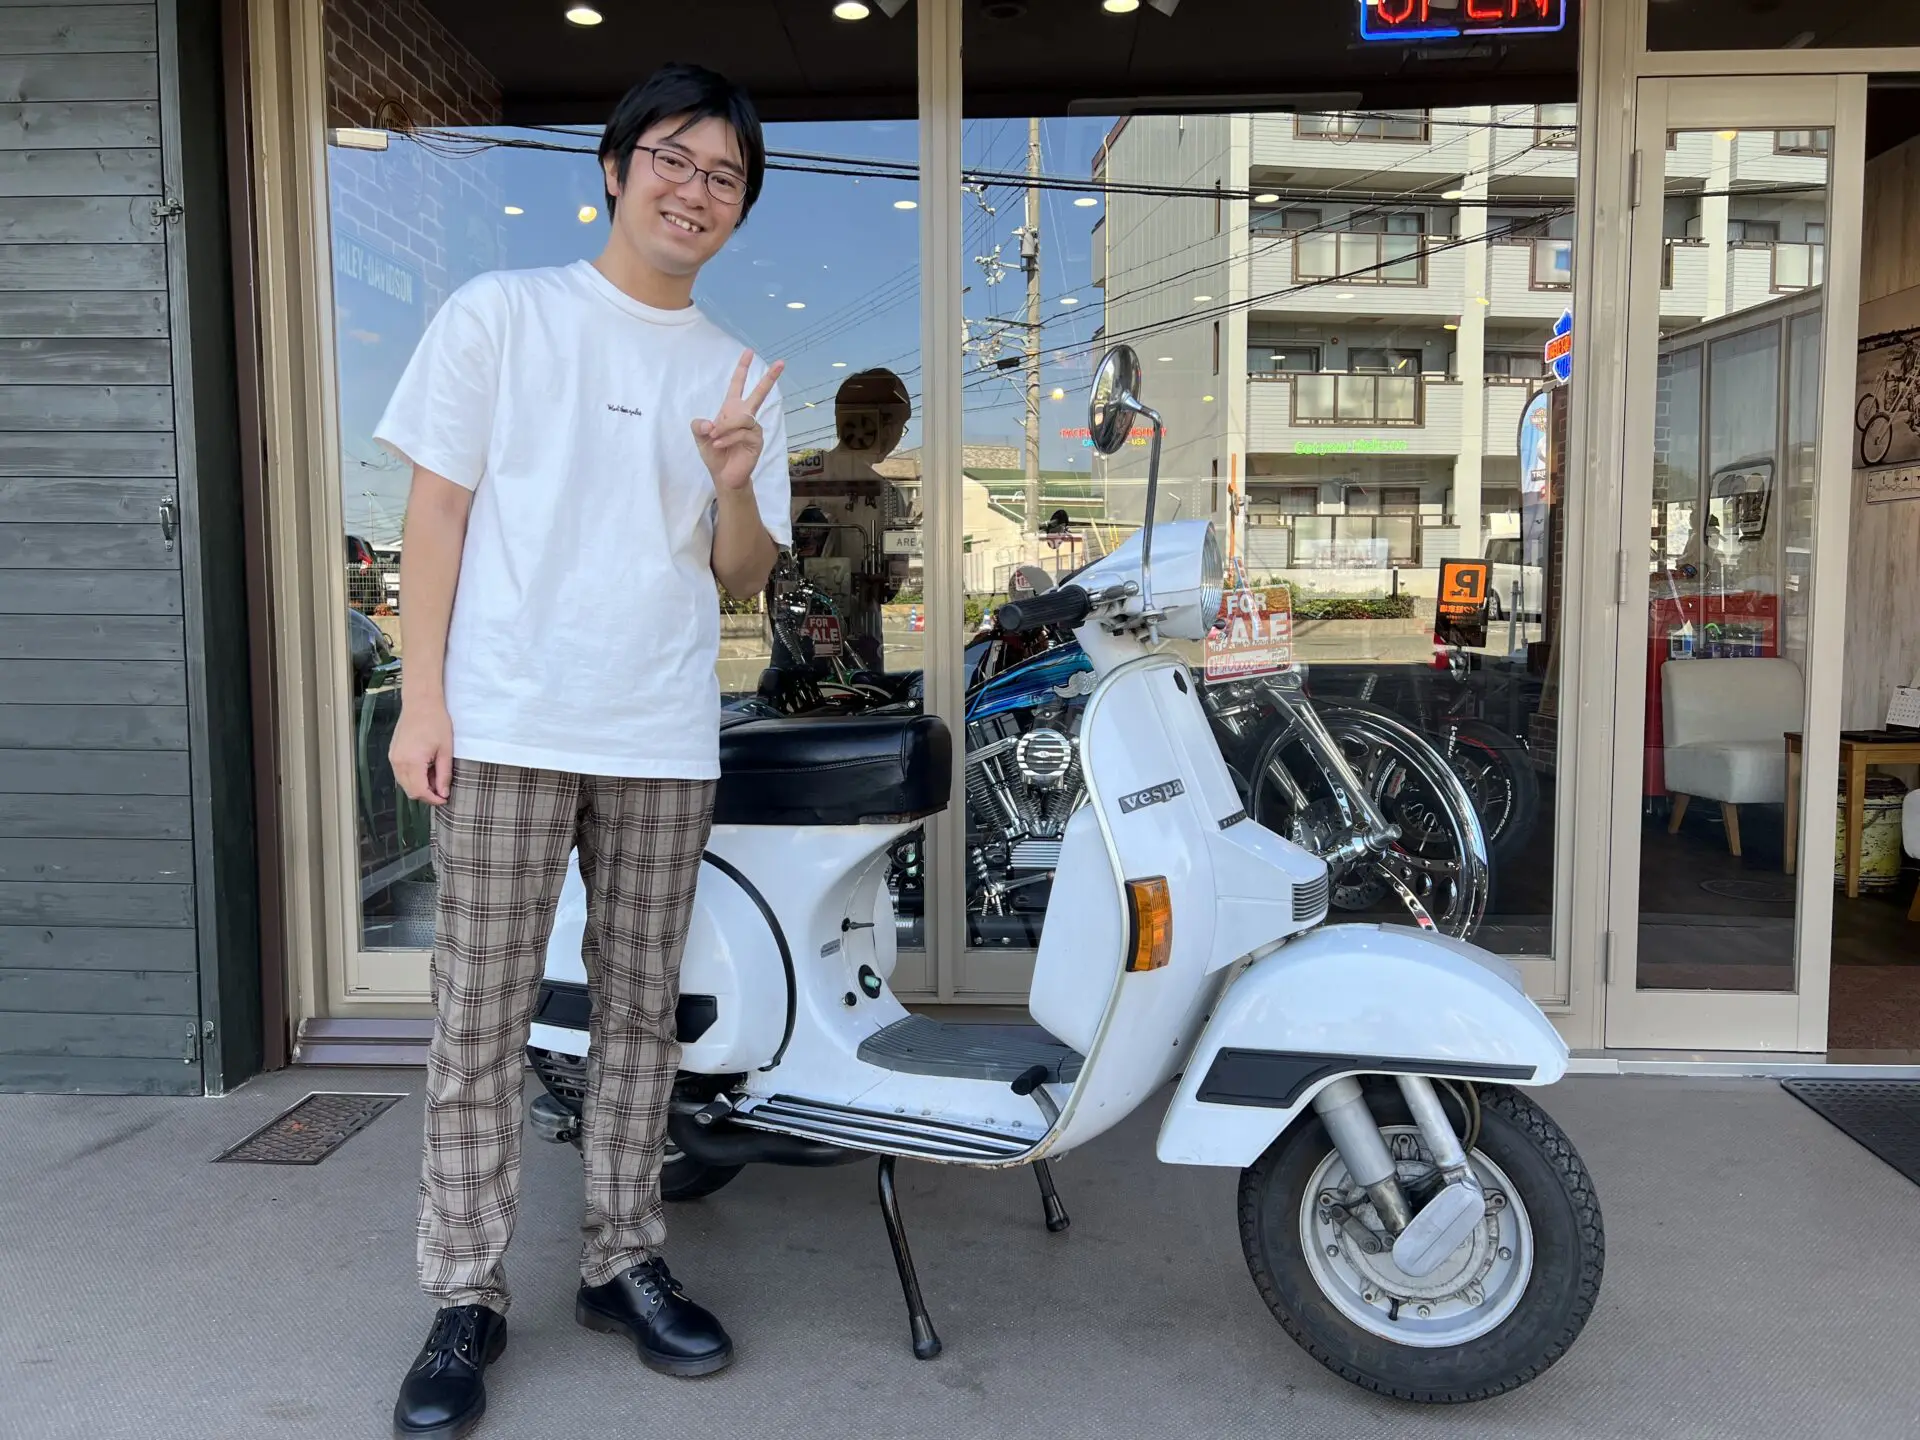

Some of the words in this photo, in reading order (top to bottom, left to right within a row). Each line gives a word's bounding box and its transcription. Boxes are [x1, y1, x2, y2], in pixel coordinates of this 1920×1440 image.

[1226, 592, 1268, 615] FOR
[810, 618, 828, 628] FOR
[1228, 612, 1289, 644] ALE
